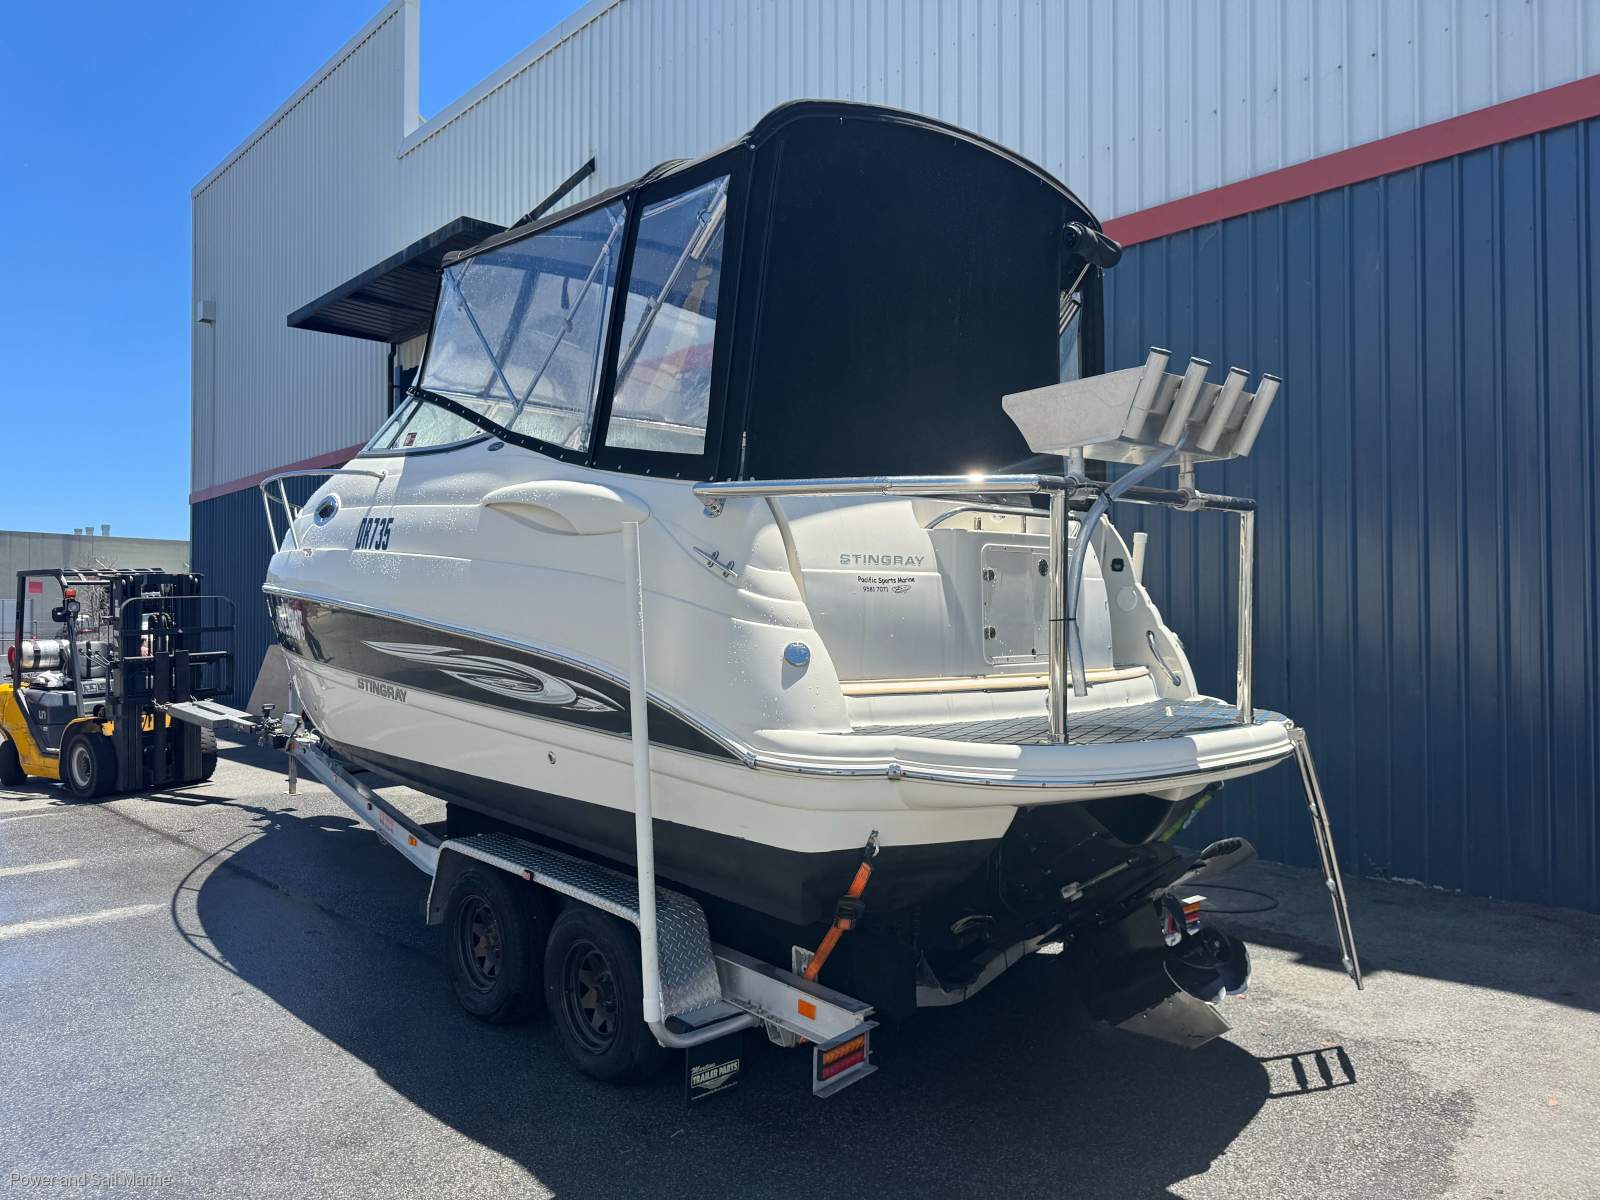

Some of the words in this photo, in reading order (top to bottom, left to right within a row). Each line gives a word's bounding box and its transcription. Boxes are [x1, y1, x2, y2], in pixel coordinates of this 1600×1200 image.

[840, 553, 925, 566] STINGRAY
[857, 575, 877, 584] Pacific
[878, 577, 896, 585] Sports
[897, 576, 916, 584] Marine
[357, 677, 407, 703] STINGRAY
[692, 1069, 718, 1085] TRAILER
[719, 1061, 738, 1076] PARTS
